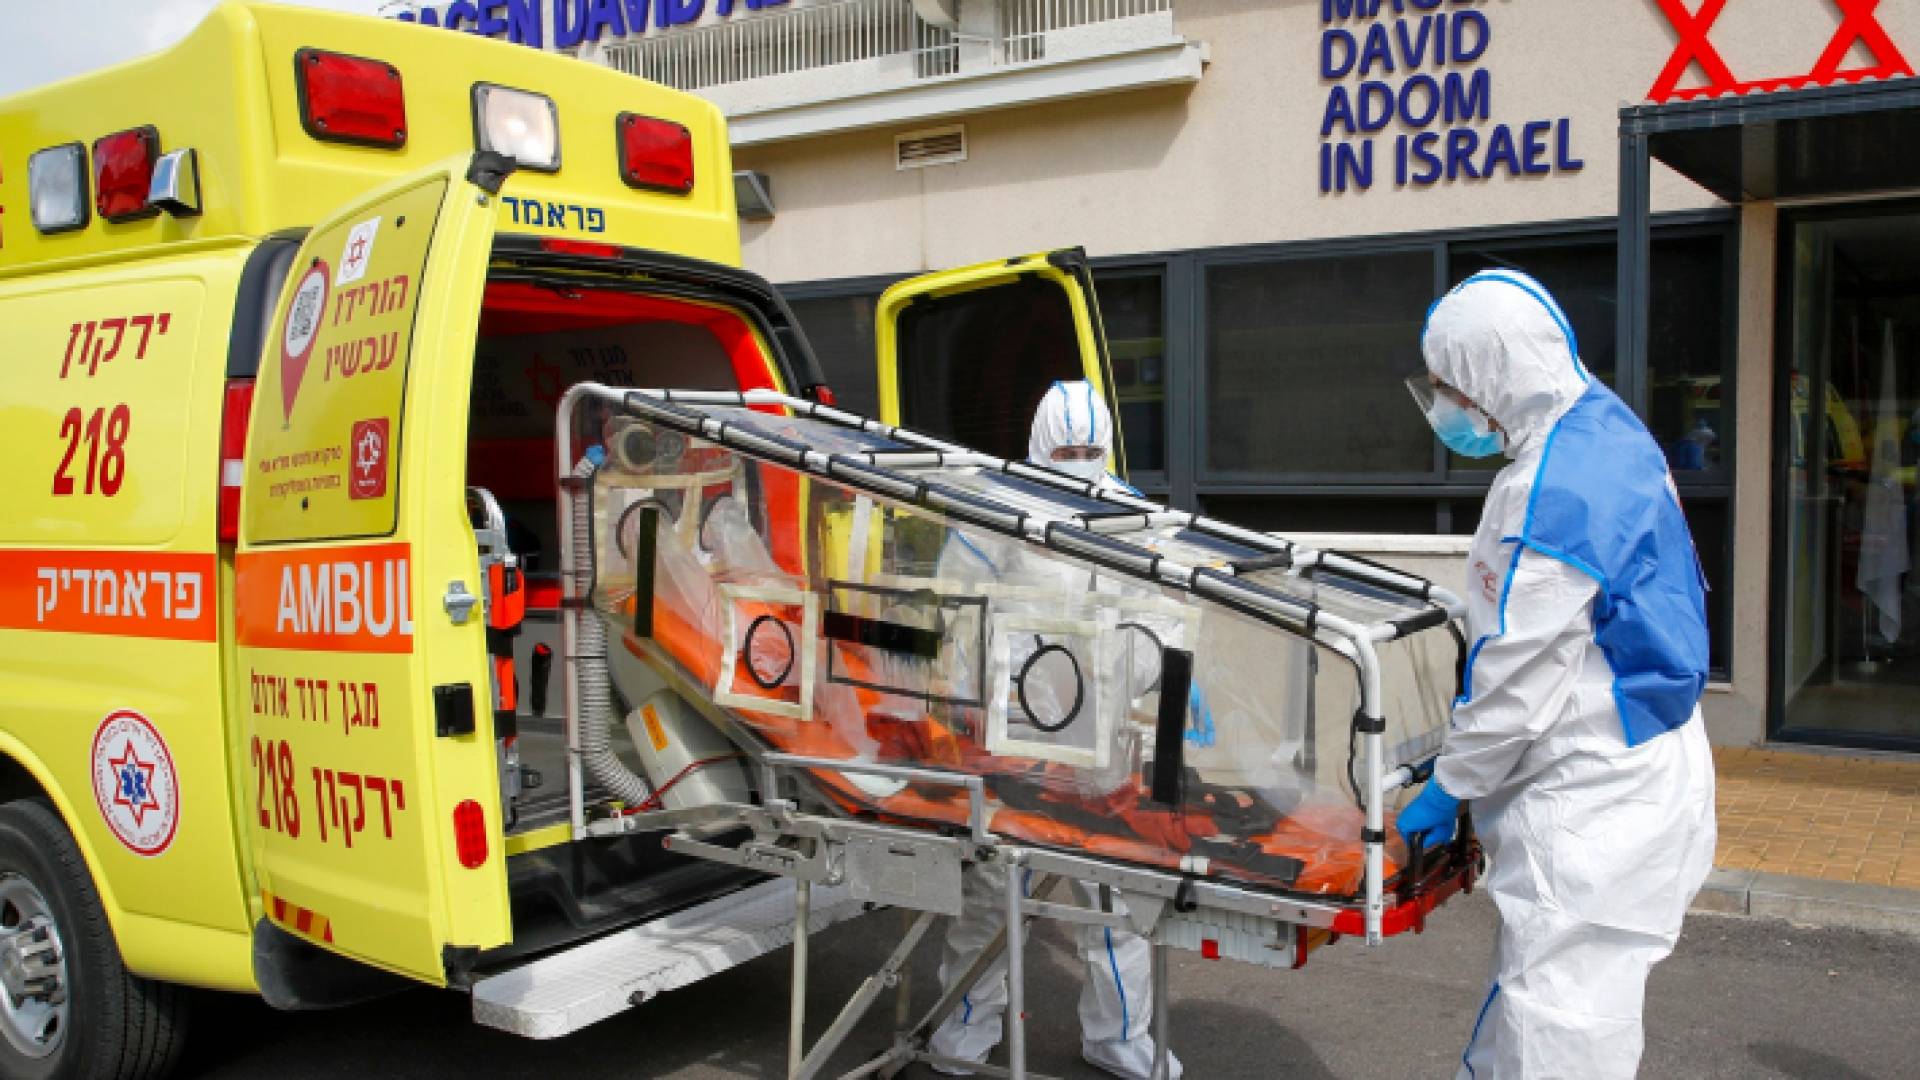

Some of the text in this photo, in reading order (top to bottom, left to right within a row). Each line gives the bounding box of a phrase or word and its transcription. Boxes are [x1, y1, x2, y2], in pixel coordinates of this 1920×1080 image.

[1321, 10, 1490, 79] DAVID
[1320, 68, 1490, 136] ADOM
[1320, 116, 1584, 192] IN ISRAEL
[333, 275, 409, 327] הורידו
[59, 312, 171, 380] ירקון
[324, 331, 400, 382] עכשיו
[52, 403, 131, 497] 218
[36, 567, 203, 623] פראמדיק
[276, 559, 413, 637] AMBUL
[294, 677, 329, 723] דוד
[338, 682, 380, 735] מגן
[251, 734, 301, 840] 218
[311, 767, 406, 849] ירקון
